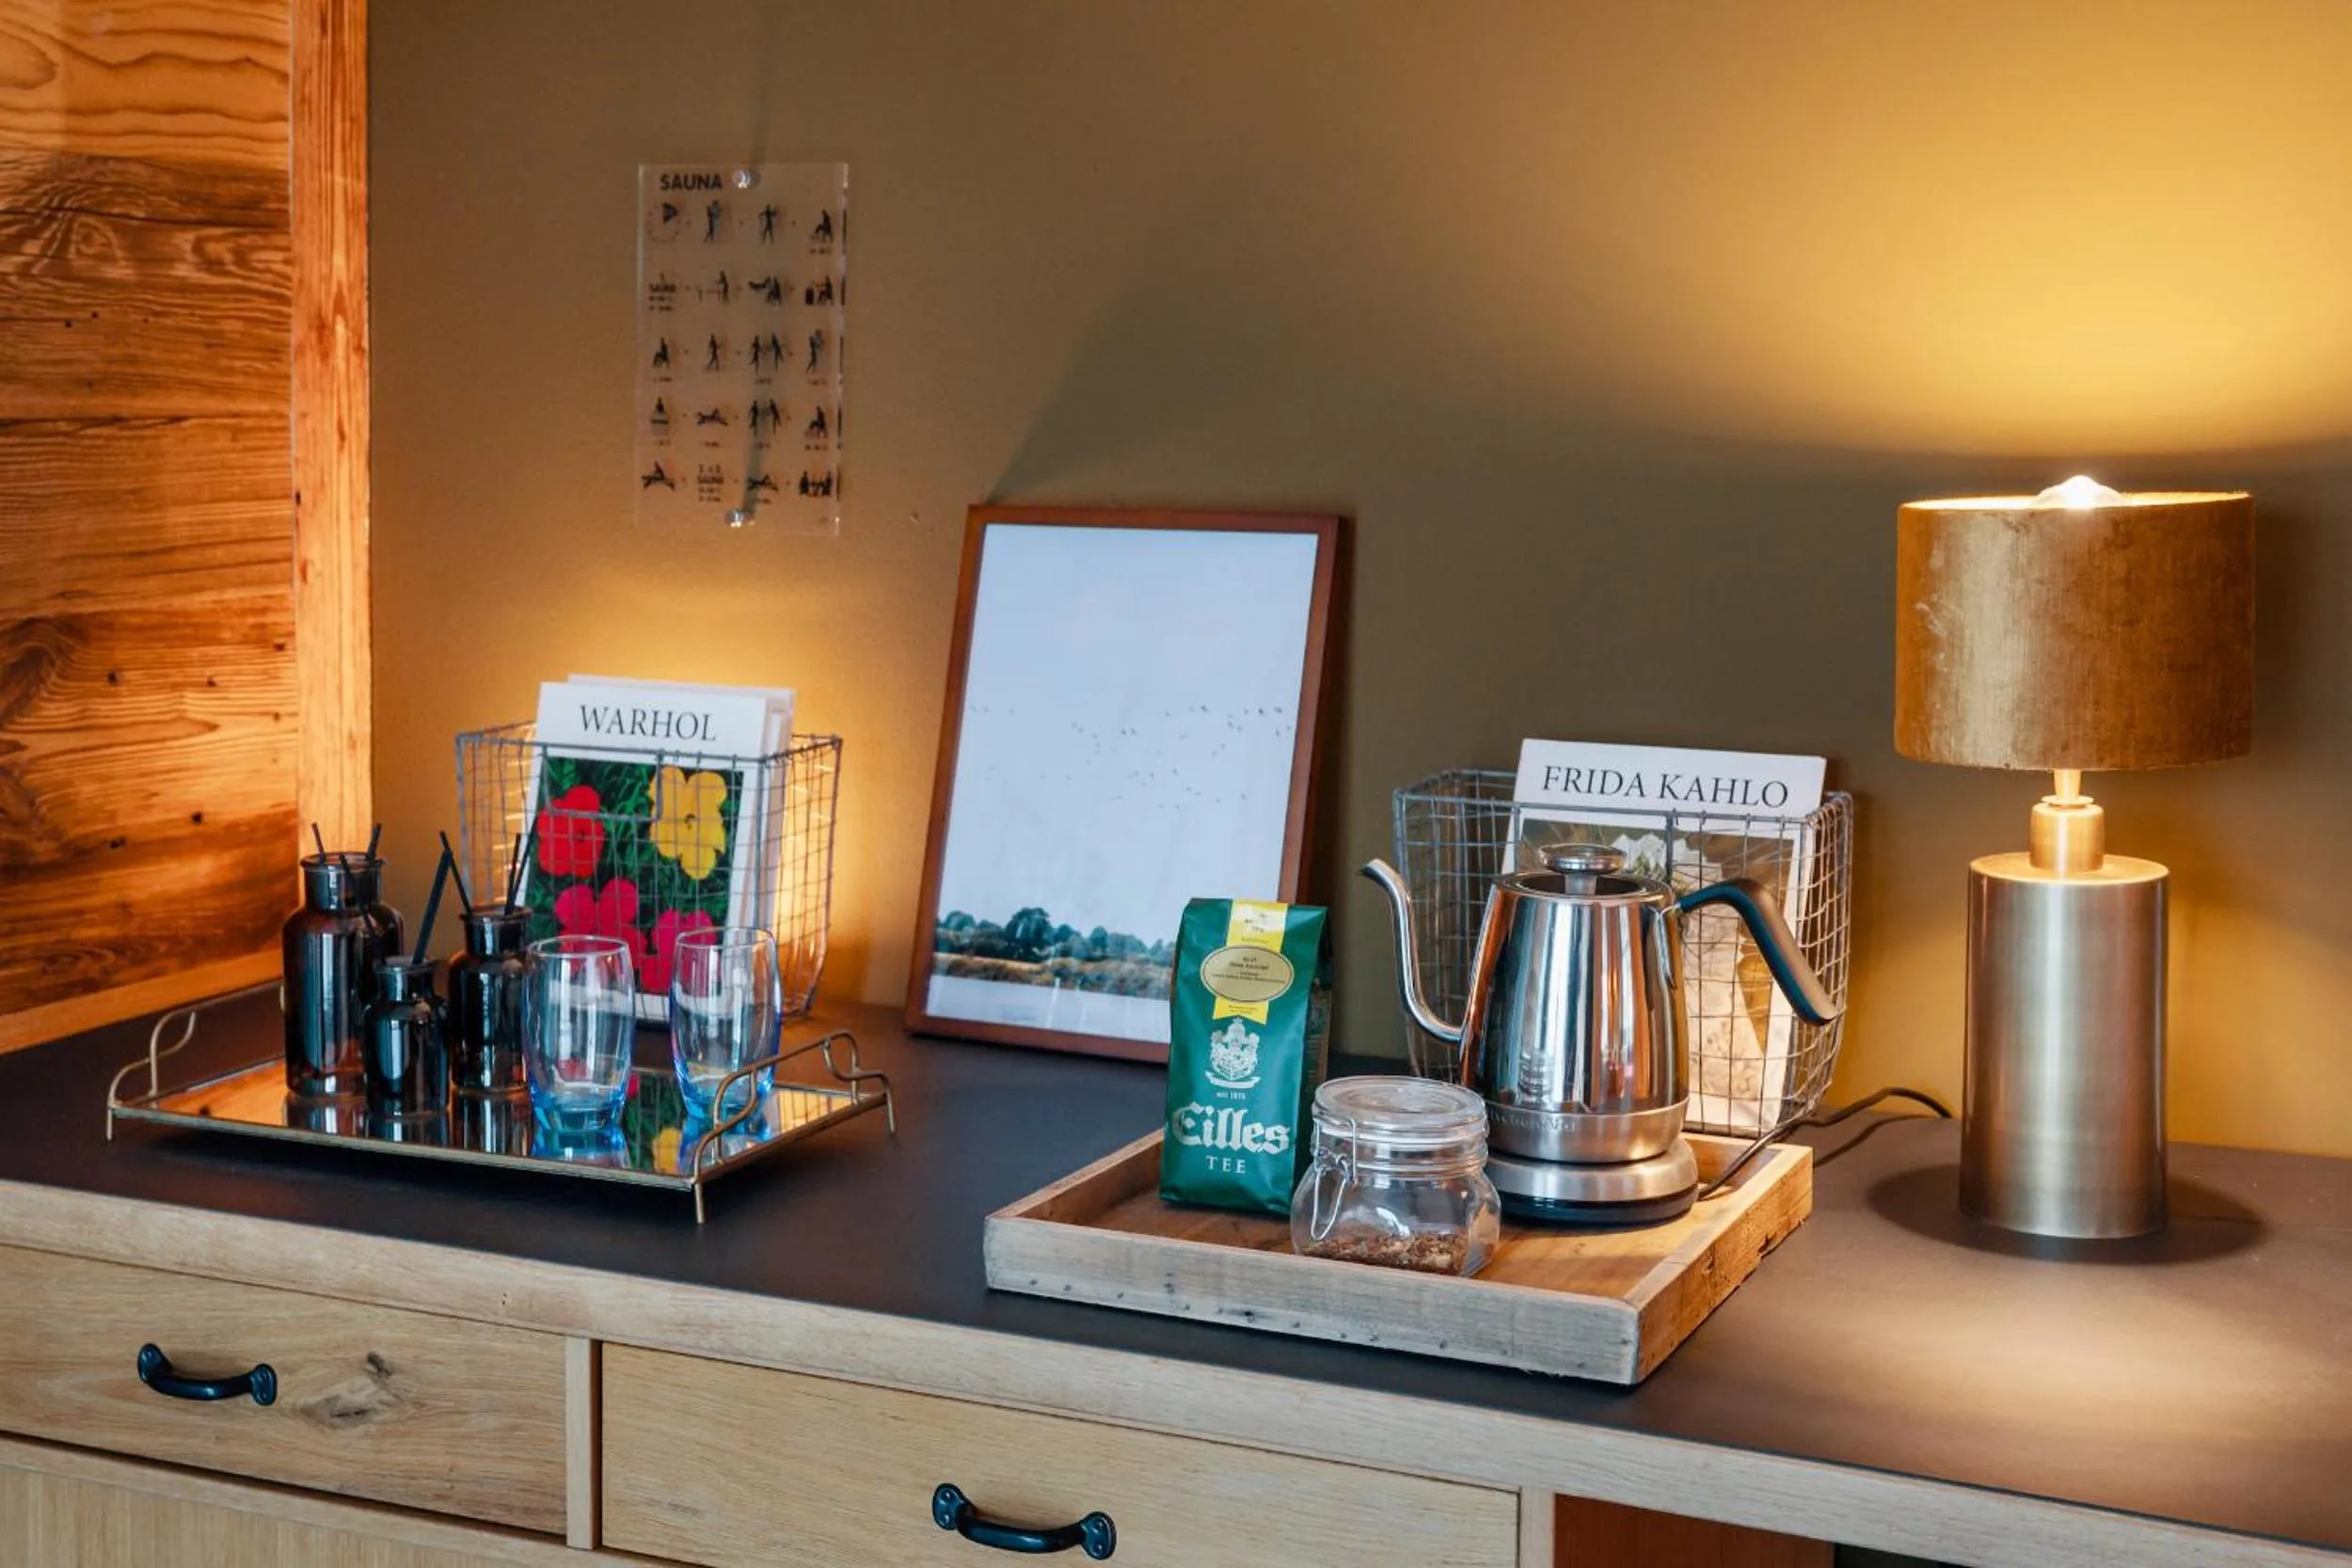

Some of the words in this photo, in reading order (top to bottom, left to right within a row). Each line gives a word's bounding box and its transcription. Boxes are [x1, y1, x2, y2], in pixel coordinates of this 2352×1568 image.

[660, 173, 723, 191] SAUNA
[580, 704, 718, 742] WARHOL
[1541, 765, 1646, 799] FRIDA
[1658, 773, 1788, 808] KAHLO
[1172, 1101, 1292, 1155] Eilles
[1205, 1155, 1247, 1175] TEE
